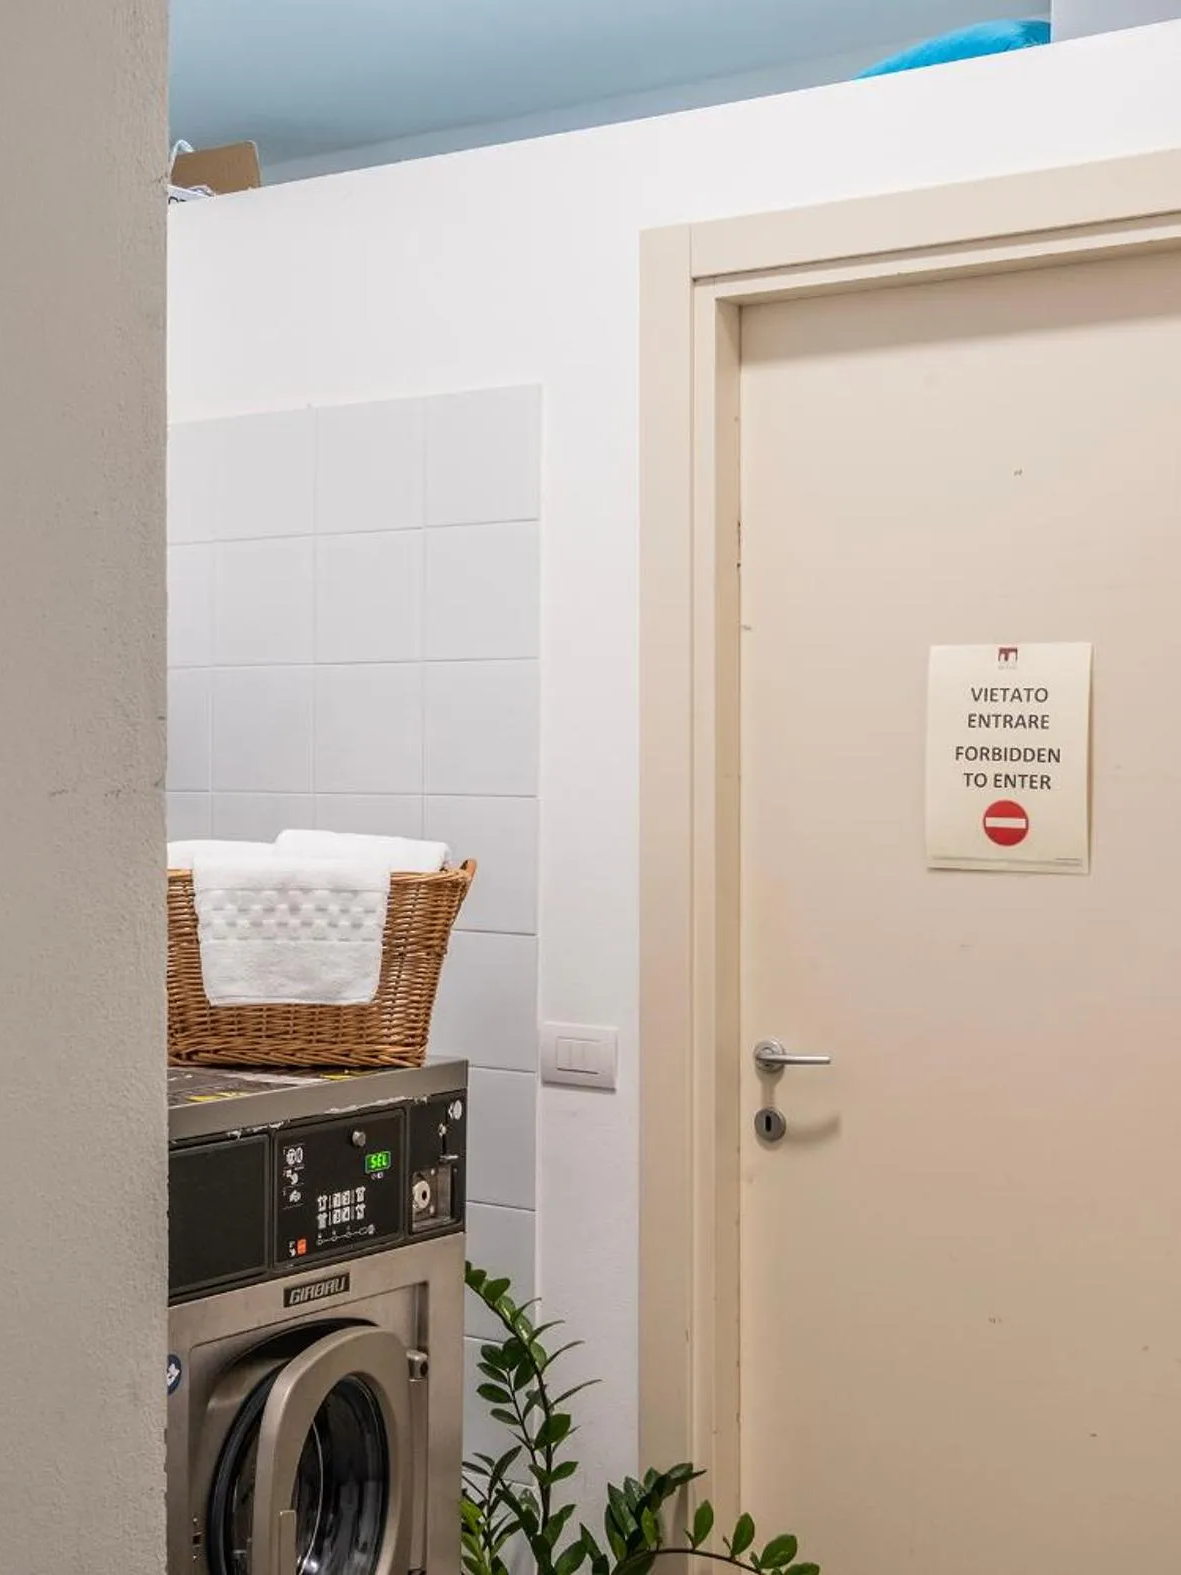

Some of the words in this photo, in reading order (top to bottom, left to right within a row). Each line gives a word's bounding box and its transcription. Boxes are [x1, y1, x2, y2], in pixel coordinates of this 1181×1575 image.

[971, 688, 1048, 703] VIETATO
[968, 713, 1049, 729] ENTRARE
[955, 746, 1060, 763] FORBIDDEN
[963, 773, 988, 788] TO
[994, 773, 1051, 790] ENTER
